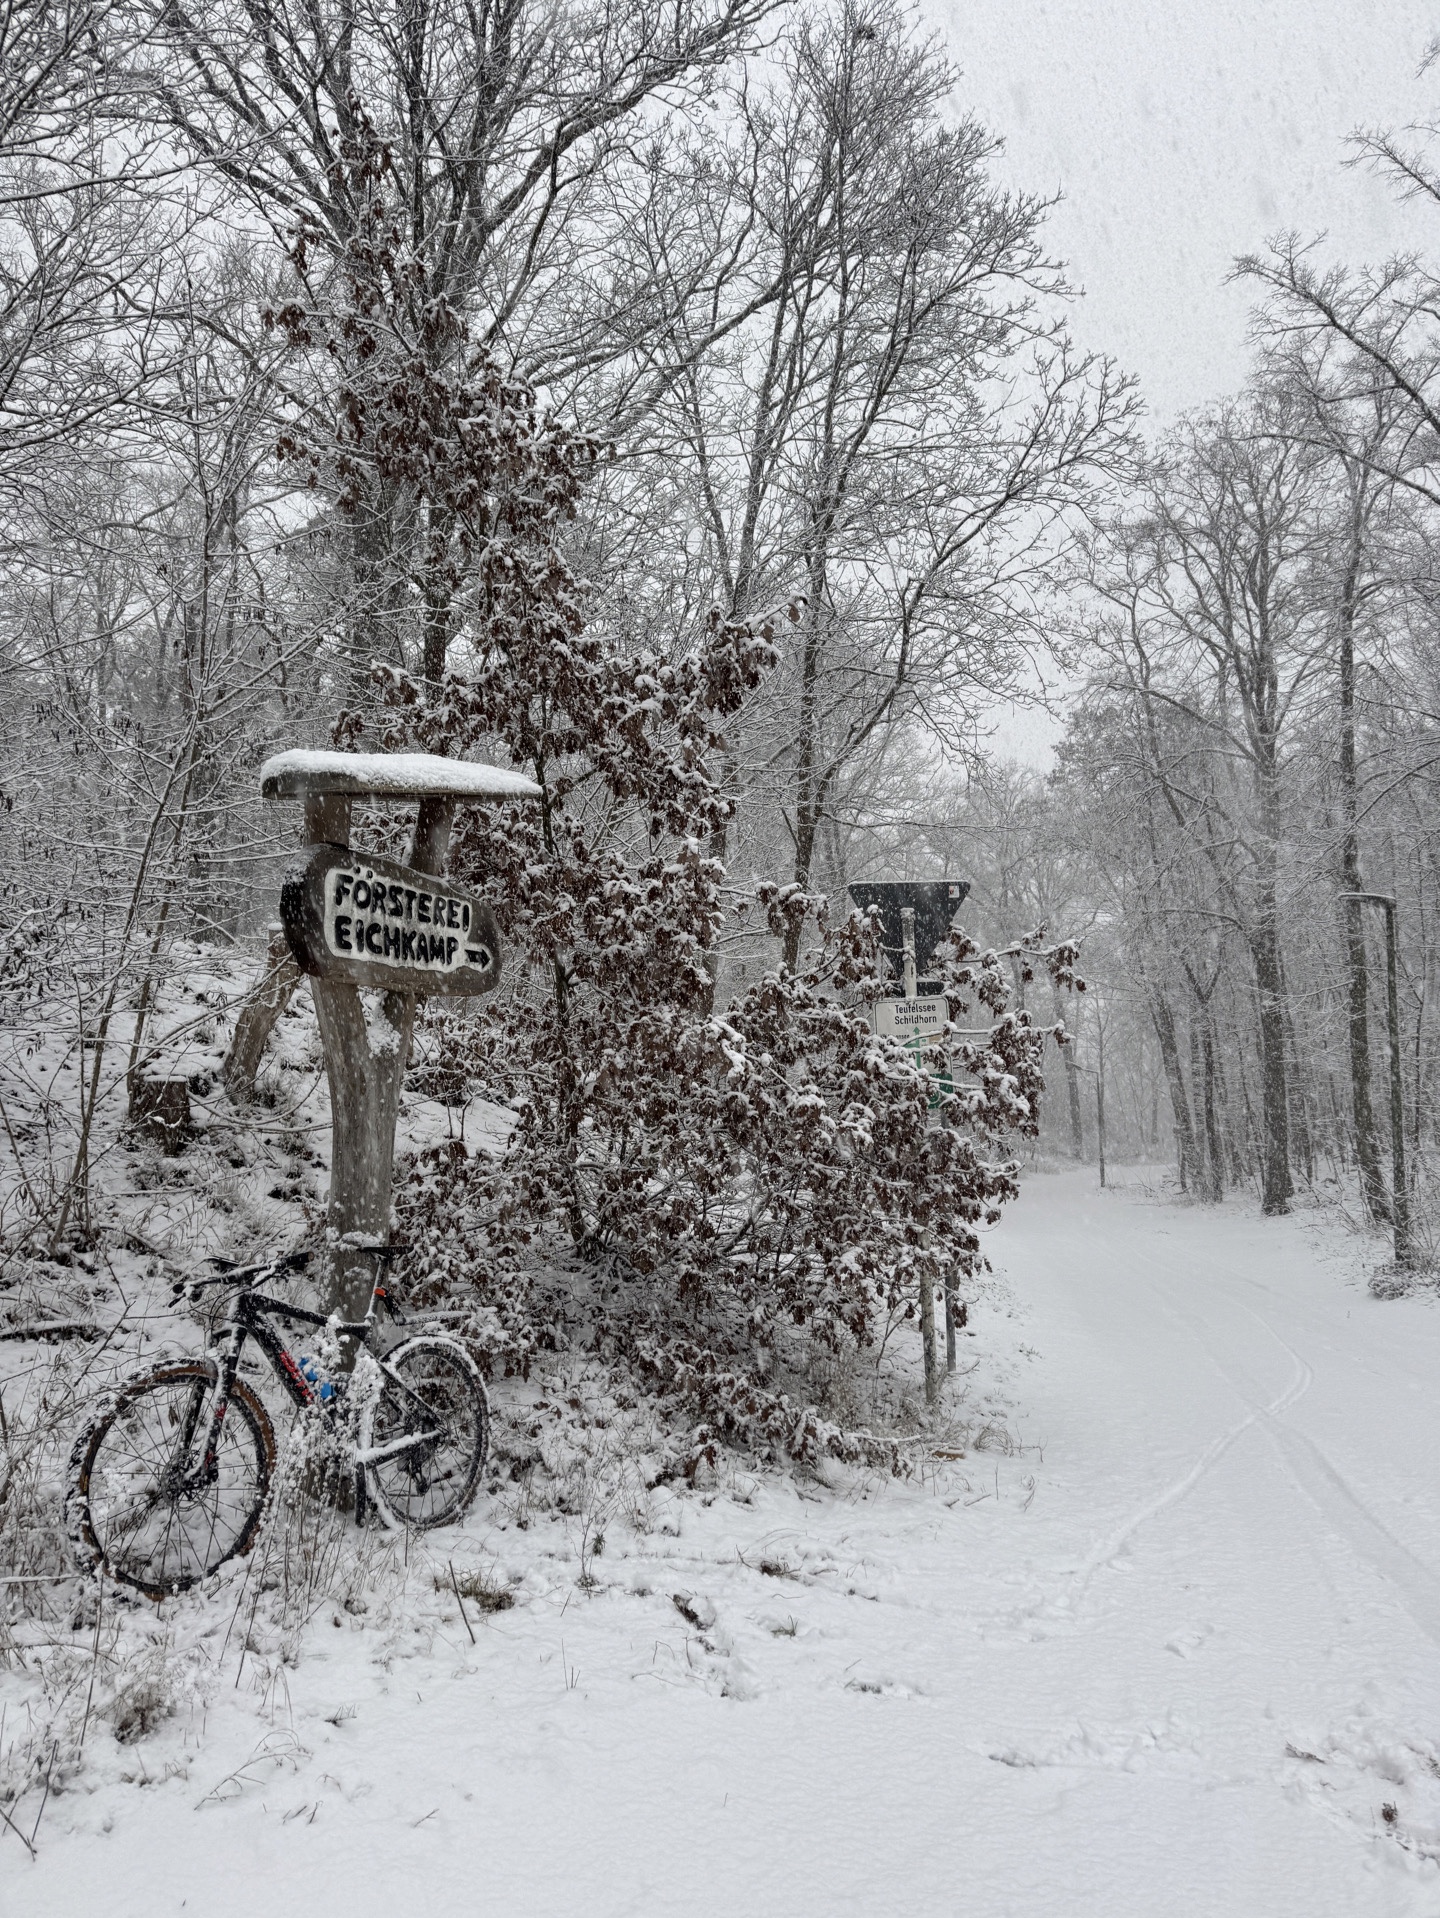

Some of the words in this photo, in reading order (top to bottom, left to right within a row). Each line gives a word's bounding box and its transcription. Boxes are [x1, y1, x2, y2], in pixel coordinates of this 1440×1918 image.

[334, 866, 470, 932] FÖRSTEREI
[334, 915, 459, 965] EICHKAMP
[895, 1003, 936, 1014] Teufelssee
[895, 1014, 937, 1025] Schildhorn
